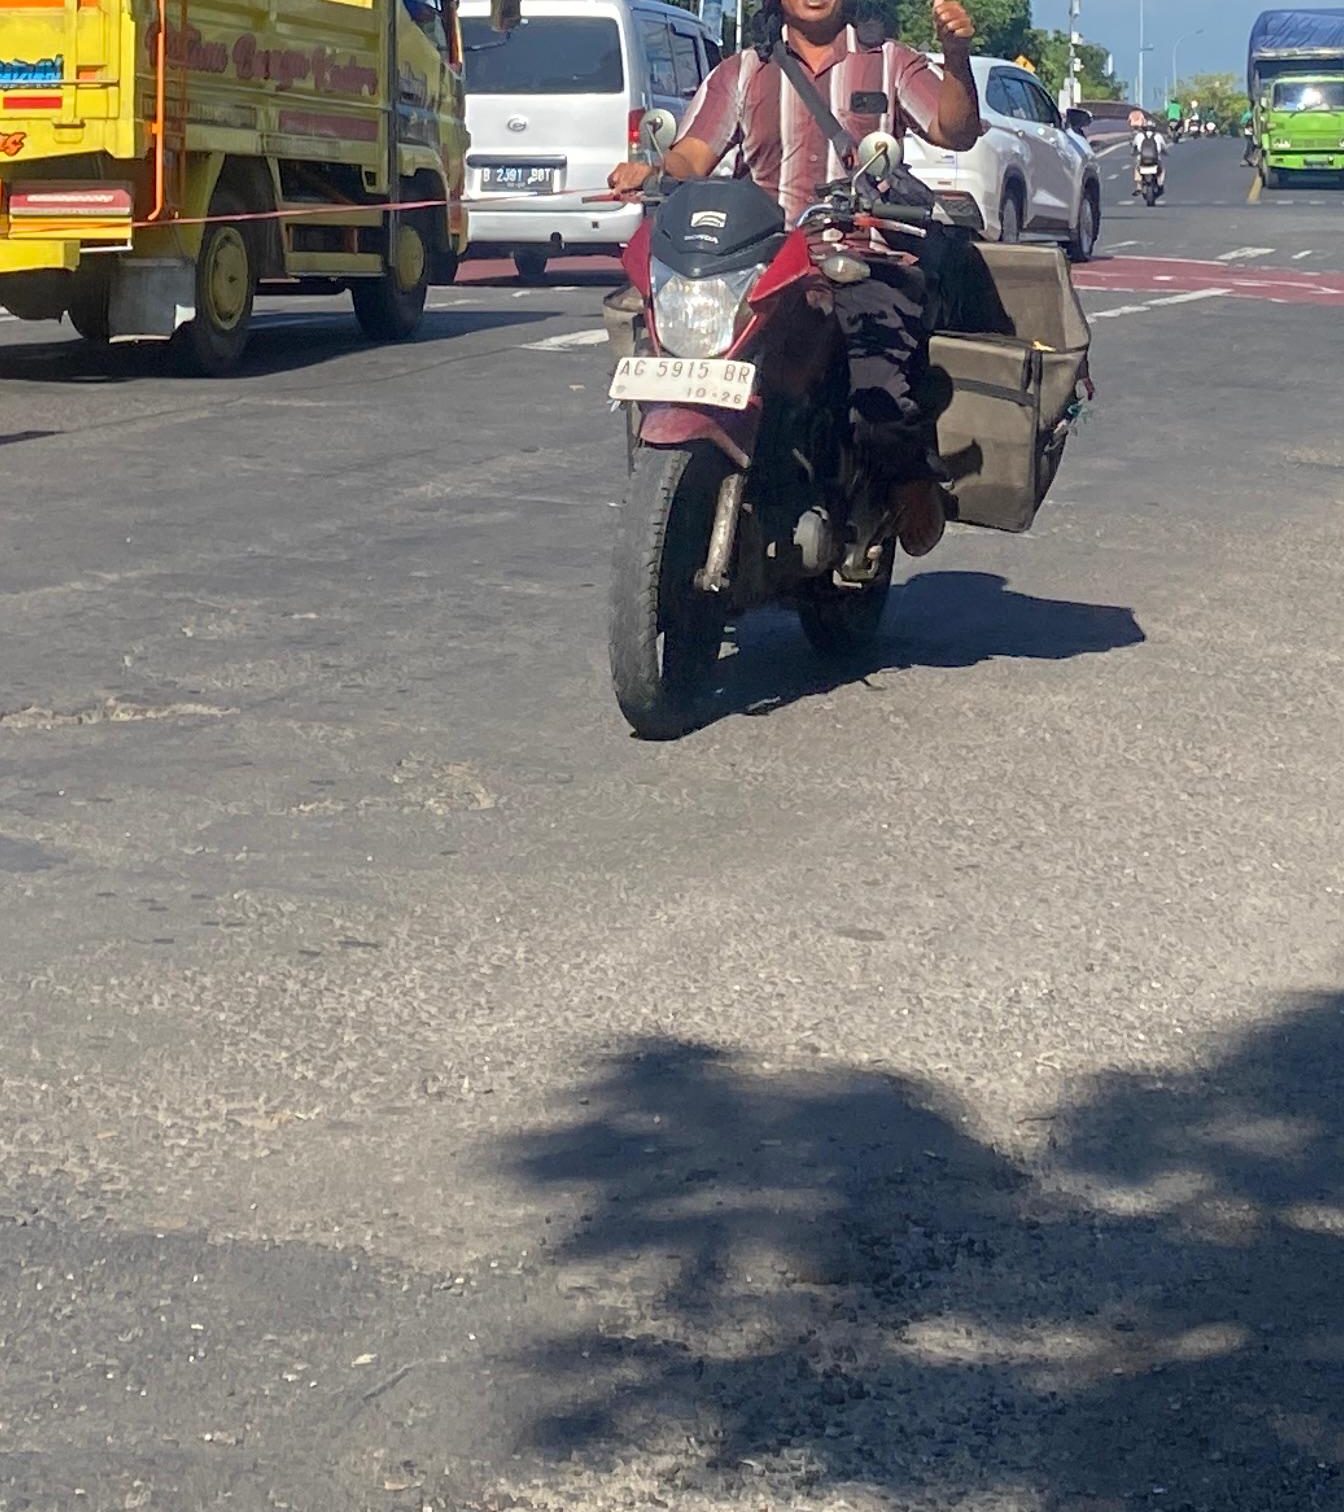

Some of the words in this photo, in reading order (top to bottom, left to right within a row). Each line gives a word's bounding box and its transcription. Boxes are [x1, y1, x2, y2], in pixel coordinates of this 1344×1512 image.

[619, 358, 647, 376] AG
[656, 360, 709, 379] 5915
[724, 364, 750, 384] BR
